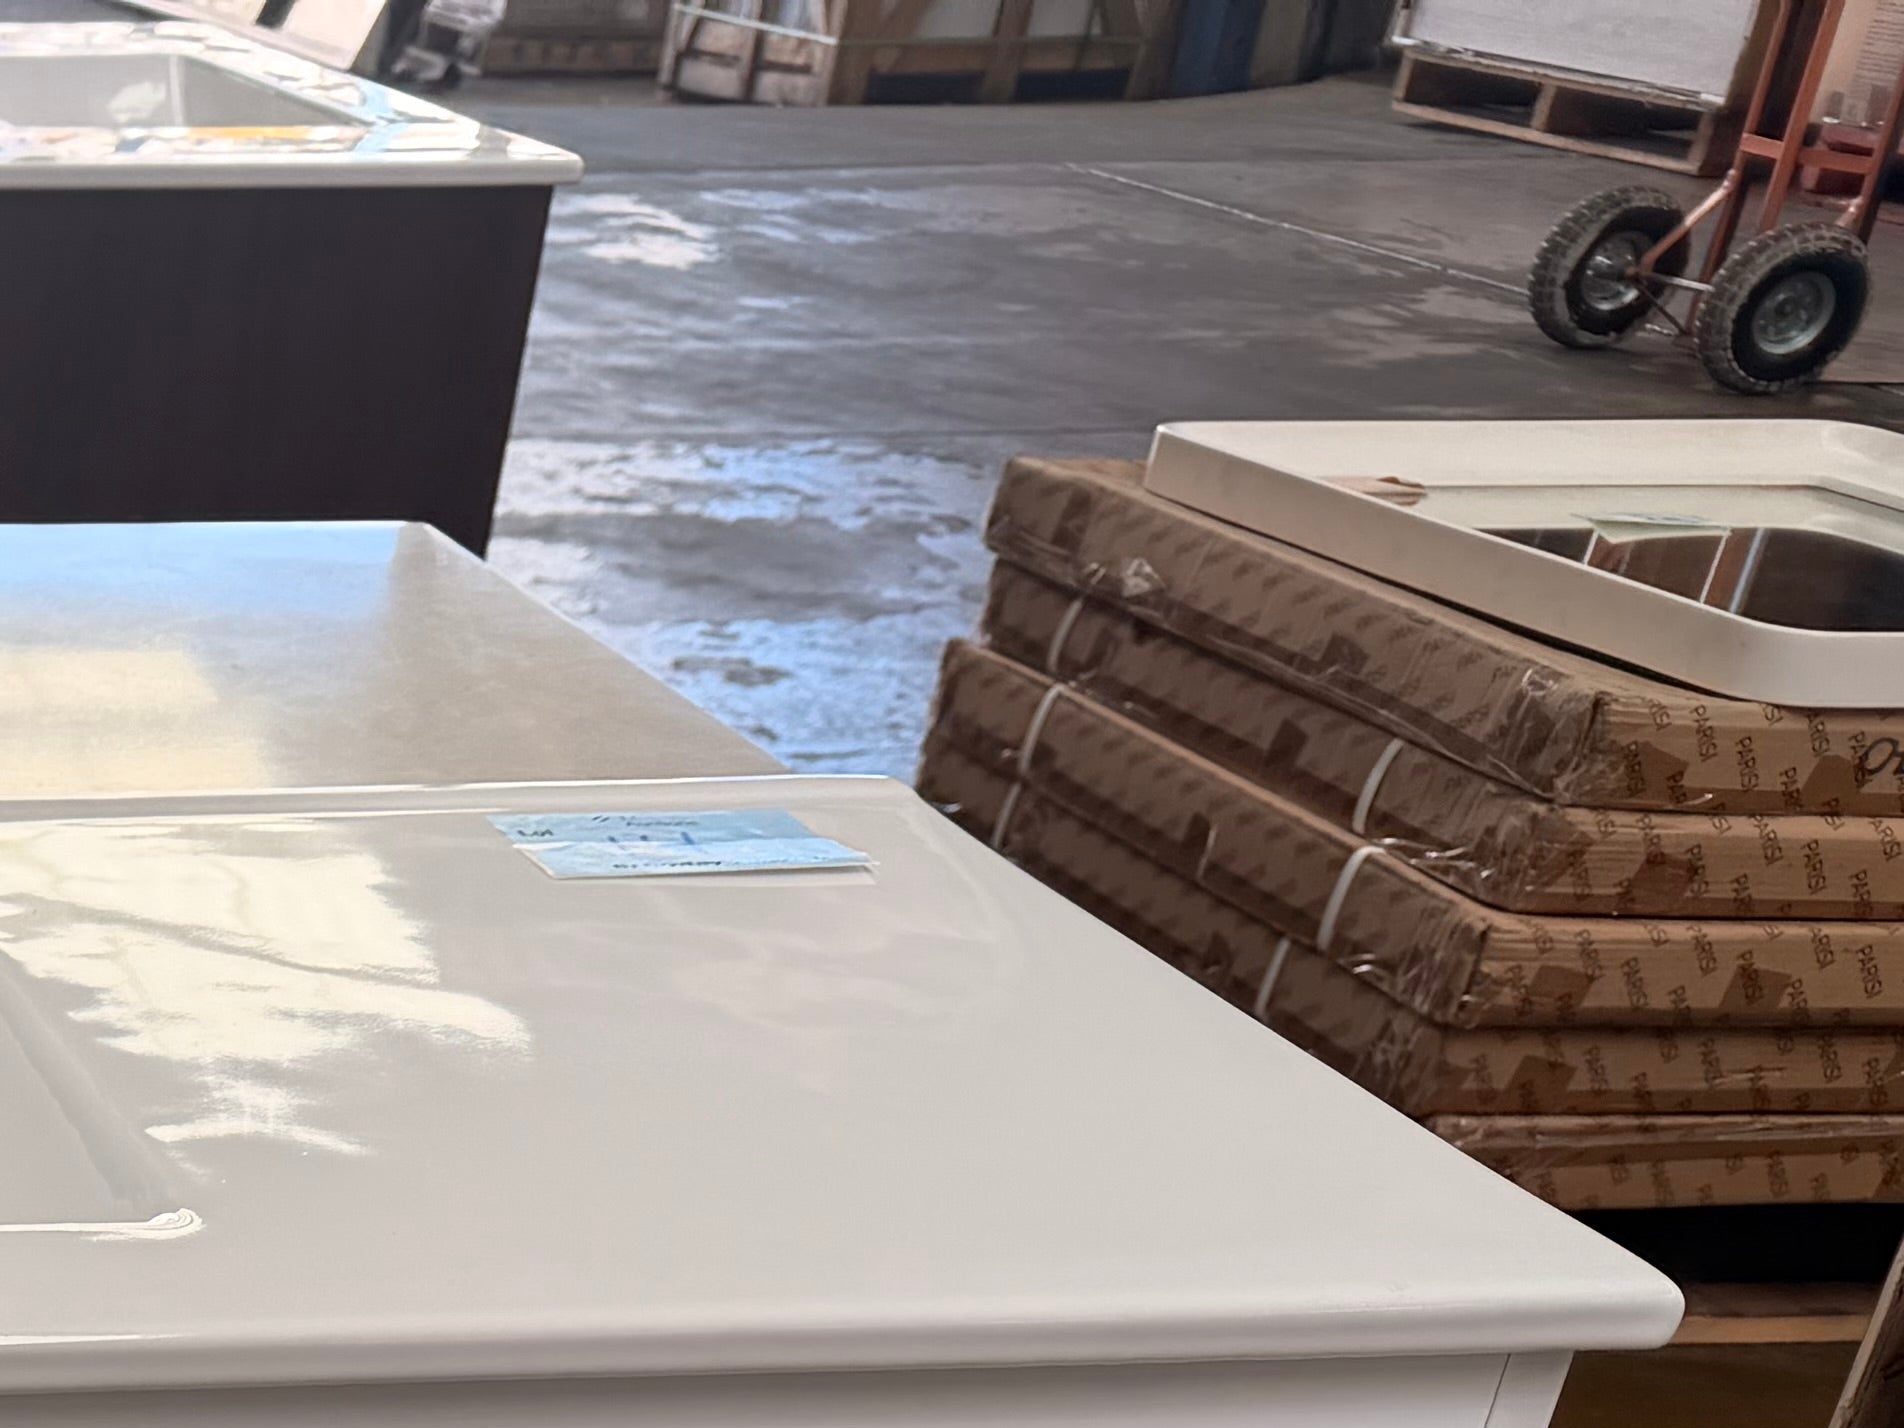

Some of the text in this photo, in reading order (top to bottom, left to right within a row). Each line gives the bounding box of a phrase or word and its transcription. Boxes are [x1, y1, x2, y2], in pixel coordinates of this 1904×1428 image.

[1690, 704, 1718, 762] PARISI
[1735, 736, 1760, 792] PARISI
[1800, 839, 1827, 895] PARISI
[1869, 819, 1902, 862] ARISI
[1737, 949, 1764, 1006] PARISI
[1856, 944, 1884, 999] PARISI
